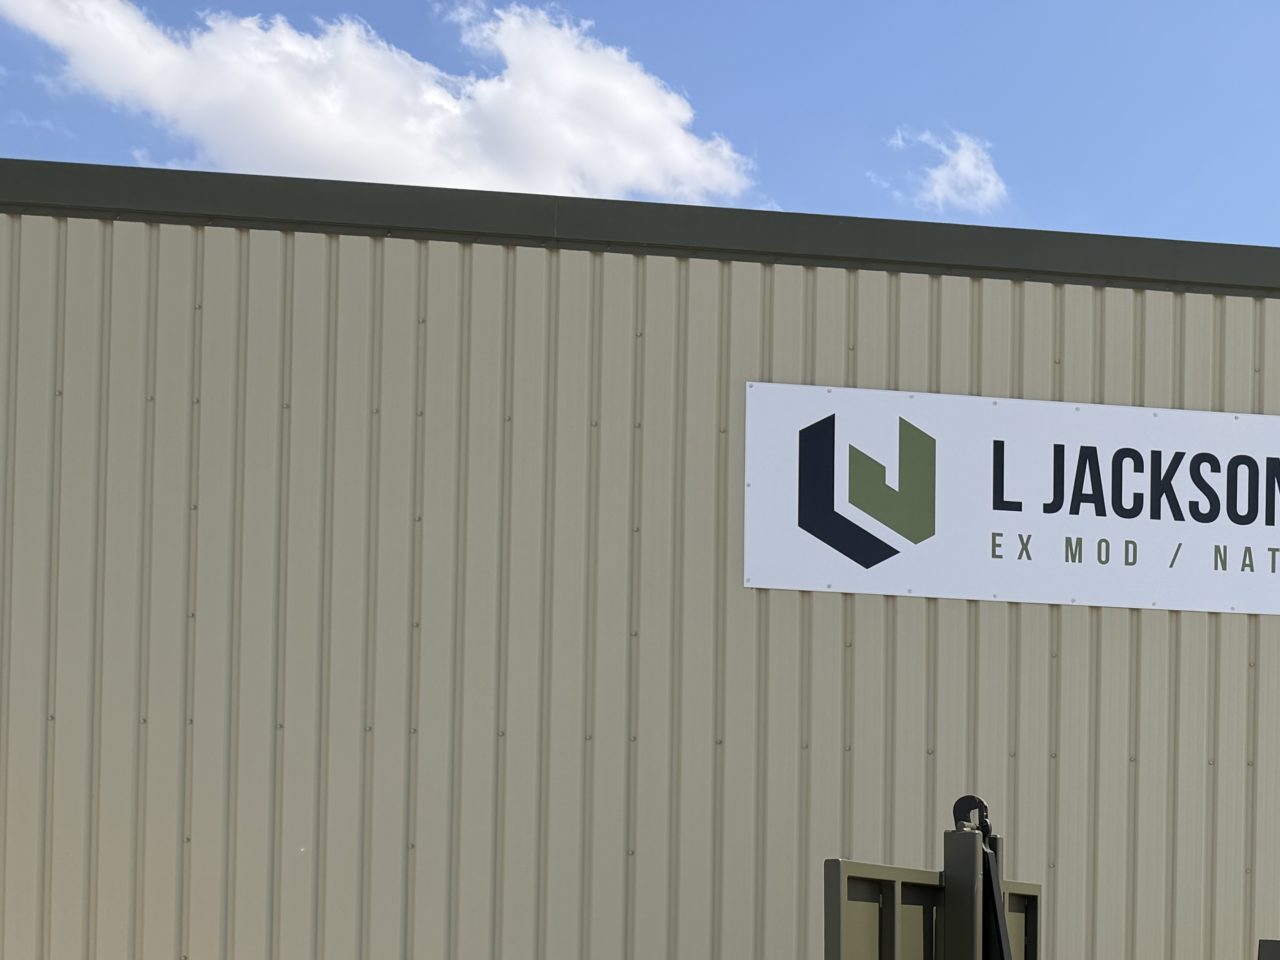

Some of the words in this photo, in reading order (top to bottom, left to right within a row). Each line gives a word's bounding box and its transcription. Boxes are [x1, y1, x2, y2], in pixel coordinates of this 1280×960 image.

[992, 439, 1023, 513] L
[991, 531, 1033, 561] EX
[1064, 536, 1138, 567] MOD
[1168, 542, 1183, 569] /
